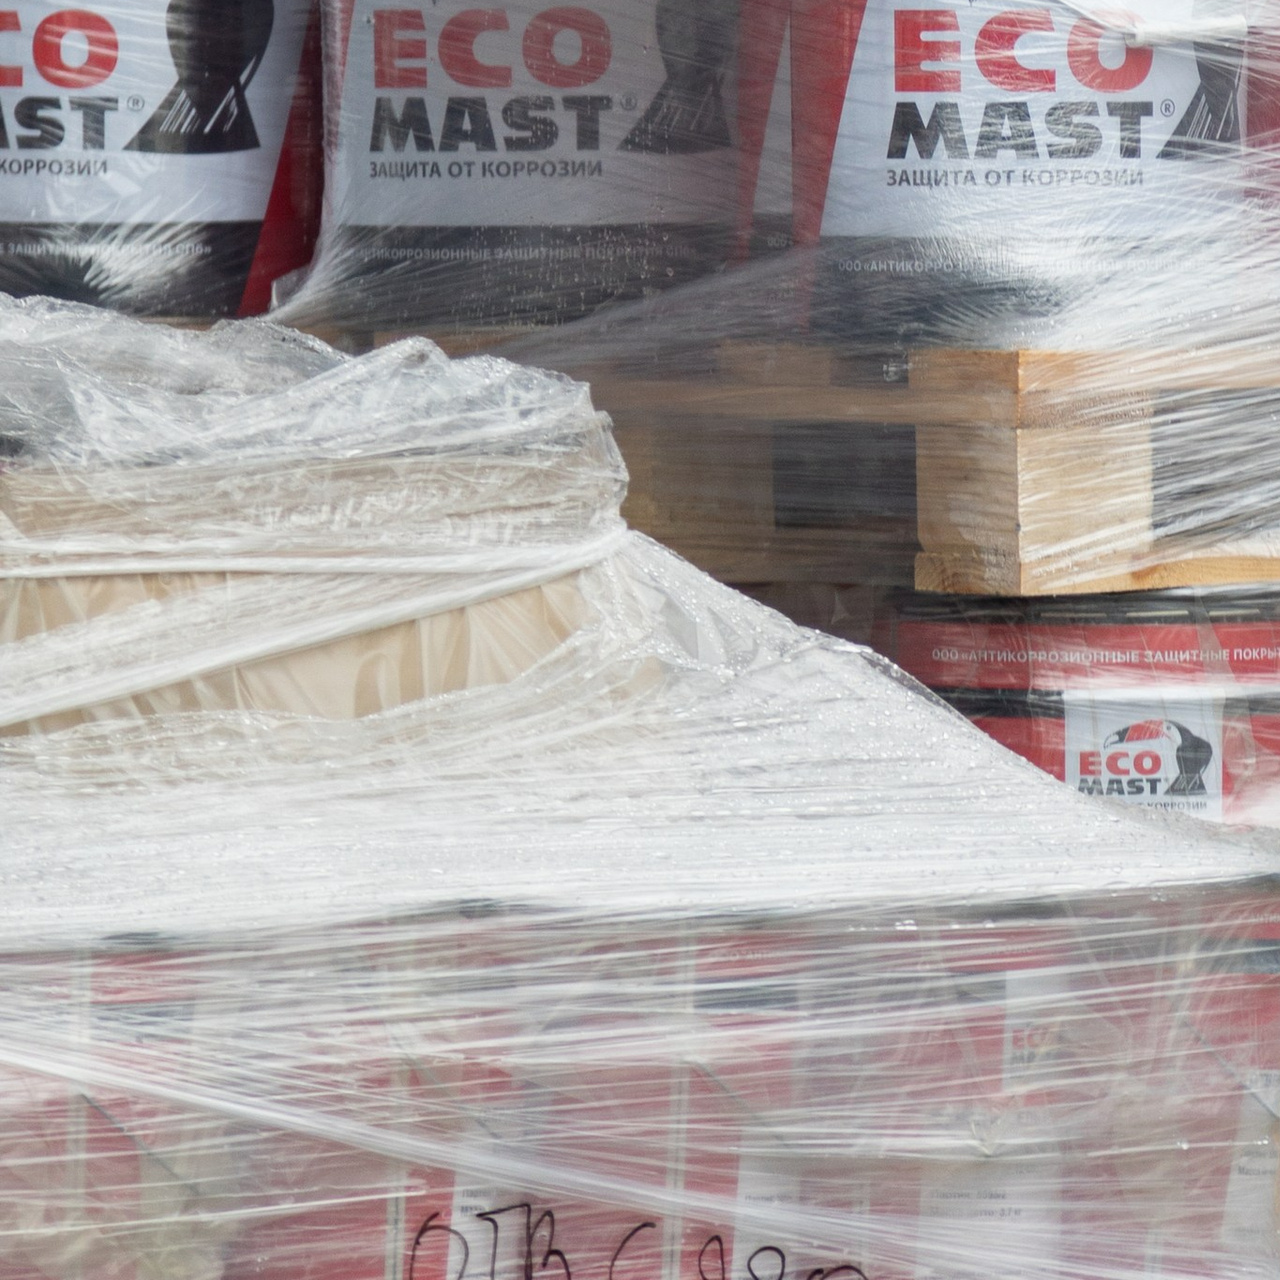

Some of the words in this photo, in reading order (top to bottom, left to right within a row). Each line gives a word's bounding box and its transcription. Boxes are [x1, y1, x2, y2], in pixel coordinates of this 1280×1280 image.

[373, 6, 613, 89] ECO
[894, 9, 1154, 93] ECO
[0, 96, 119, 151] ST
[369, 96, 613, 152] MAST
[886, 101, 1154, 160] MAST
[369, 161, 441, 182] ЗАЩИТА
[447, 161, 475, 179] ОТ
[482, 160, 602, 179] КОРРОЗИИ
[886, 169, 977, 189] ЗАЩИТА
[985, 169, 1014, 186] ОТ
[1022, 169, 1144, 186] КОРРОЗИИ
[932, 648, 959, 662] ООО
[1144, 647, 1230, 665] ЗАЩИТНЫЕ
[1079, 750, 1162, 776] ECO
[1078, 777, 1163, 796] MAST
